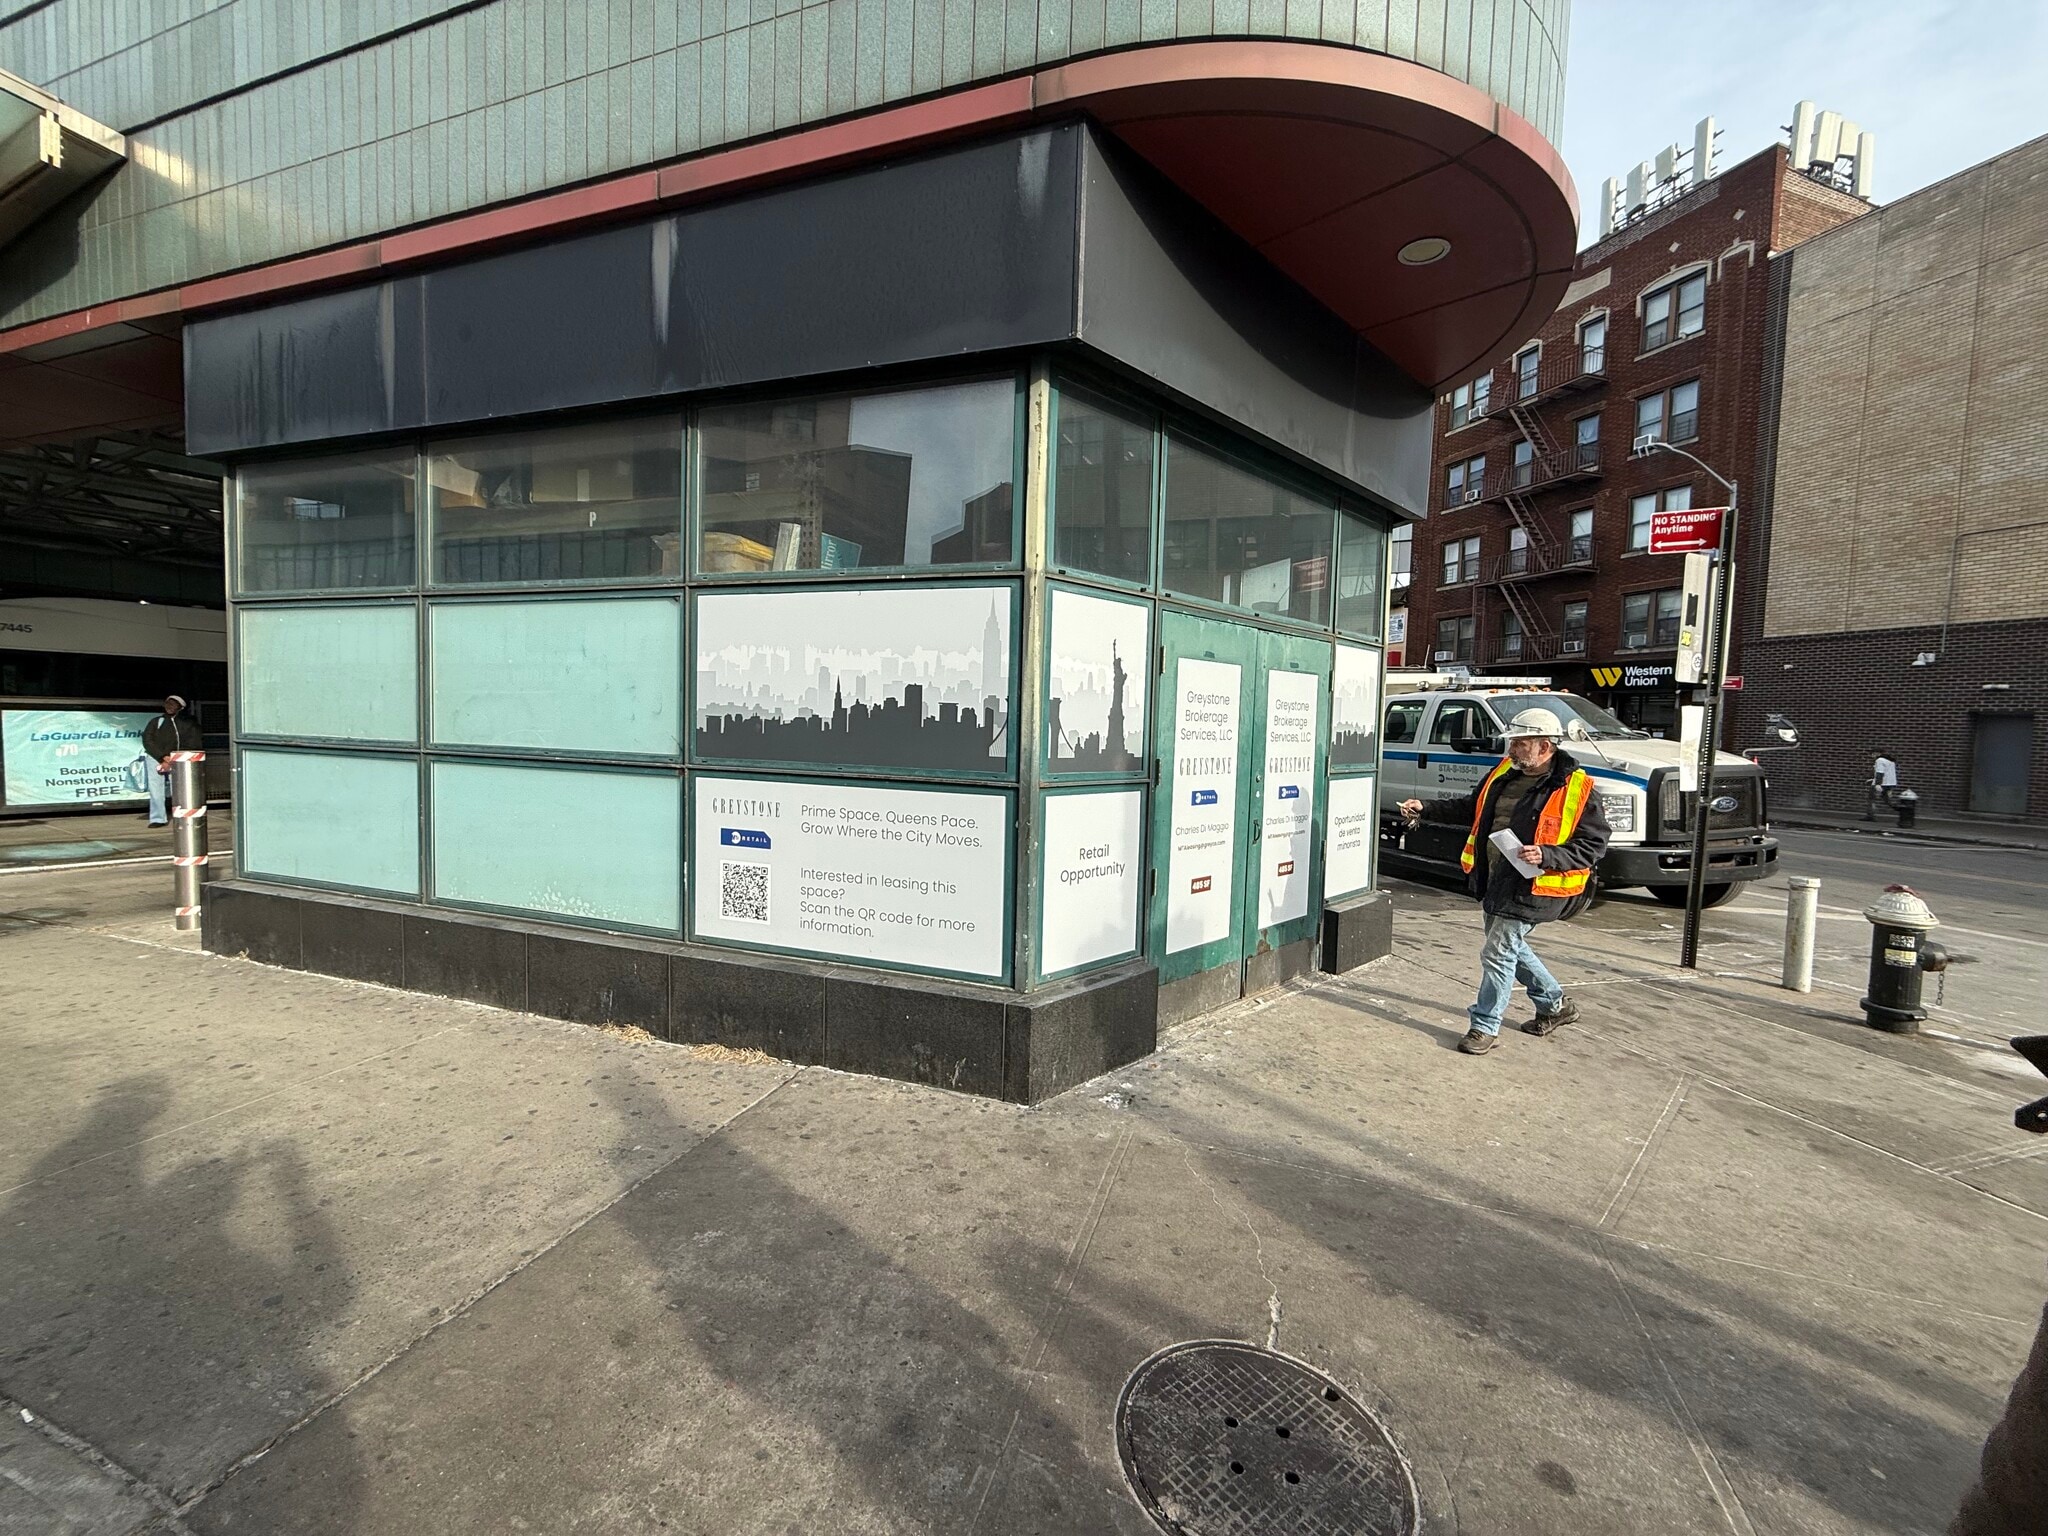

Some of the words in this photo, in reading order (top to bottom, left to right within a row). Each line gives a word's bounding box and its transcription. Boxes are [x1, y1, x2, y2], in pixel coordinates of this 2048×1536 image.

[1654, 516, 1668, 526] NO
[1669, 513, 1716, 524] STANDING
[1654, 525, 1693, 535] Anytime
[1625, 666, 1672, 676] Western
[1625, 676, 1658, 686] Union
[1187, 690, 1230, 708] Greystone
[1275, 699, 1310, 714] Greystone
[1185, 710, 1228, 726] Brokerage
[1274, 715, 1308, 730] Brokerage
[30, 730, 111, 741] LaGuardia
[115, 730, 144, 739] Link
[1180, 728, 1217, 742] Services,
[1220, 729, 1232, 741] LLC
[1270, 732, 1299, 743] Services,
[1301, 732, 1311, 742] LLC
[60, 766, 99, 776] Board
[1180, 757, 1232, 776] GREYSTONE
[1269, 757, 1310, 773] GREYSTONE
[45, 776, 101, 787] Nonstop
[104, 775, 116, 783] to
[75, 786, 120, 797] FREE
[712, 797, 780, 818] GREYSTONE
[801, 805, 836, 818] Prime
[839, 808, 882, 823] Space.
[886, 810, 937, 826] Queens
[941, 814, 978, 829] Pace.
[1266, 816, 1284, 826] Charles
[1335, 811, 1366, 828] Oportunidad
[800, 822, 834, 835] Grow
[836, 824, 878, 839] Where
[881, 828, 902, 841] the
[906, 830, 932, 846] City
[935, 832, 983, 848] Moves.
[1176, 826, 1199, 836] Charles
[1200, 824, 1206, 832] Di
[1339, 829, 1345, 838] de
[1347, 827, 1360, 836] venta
[1079, 844, 1110, 860] Retail
[1337, 839, 1361, 851] minorista
[800, 868, 862, 884] Interested
[866, 873, 878, 886] in
[881, 875, 928, 894] leasing
[932, 881, 957, 894] this
[1060, 862, 1126, 886] Opportunity
[1203, 880, 1210, 888] SF
[800, 886, 845, 900] space?
[800, 901, 830, 915] Scan
[834, 905, 855, 918] the
[858, 908, 876, 921] QR
[879, 912, 913, 925] code
[916, 914, 935, 927] for
[938, 919, 976, 932] more
[800, 917, 875, 938] information.
